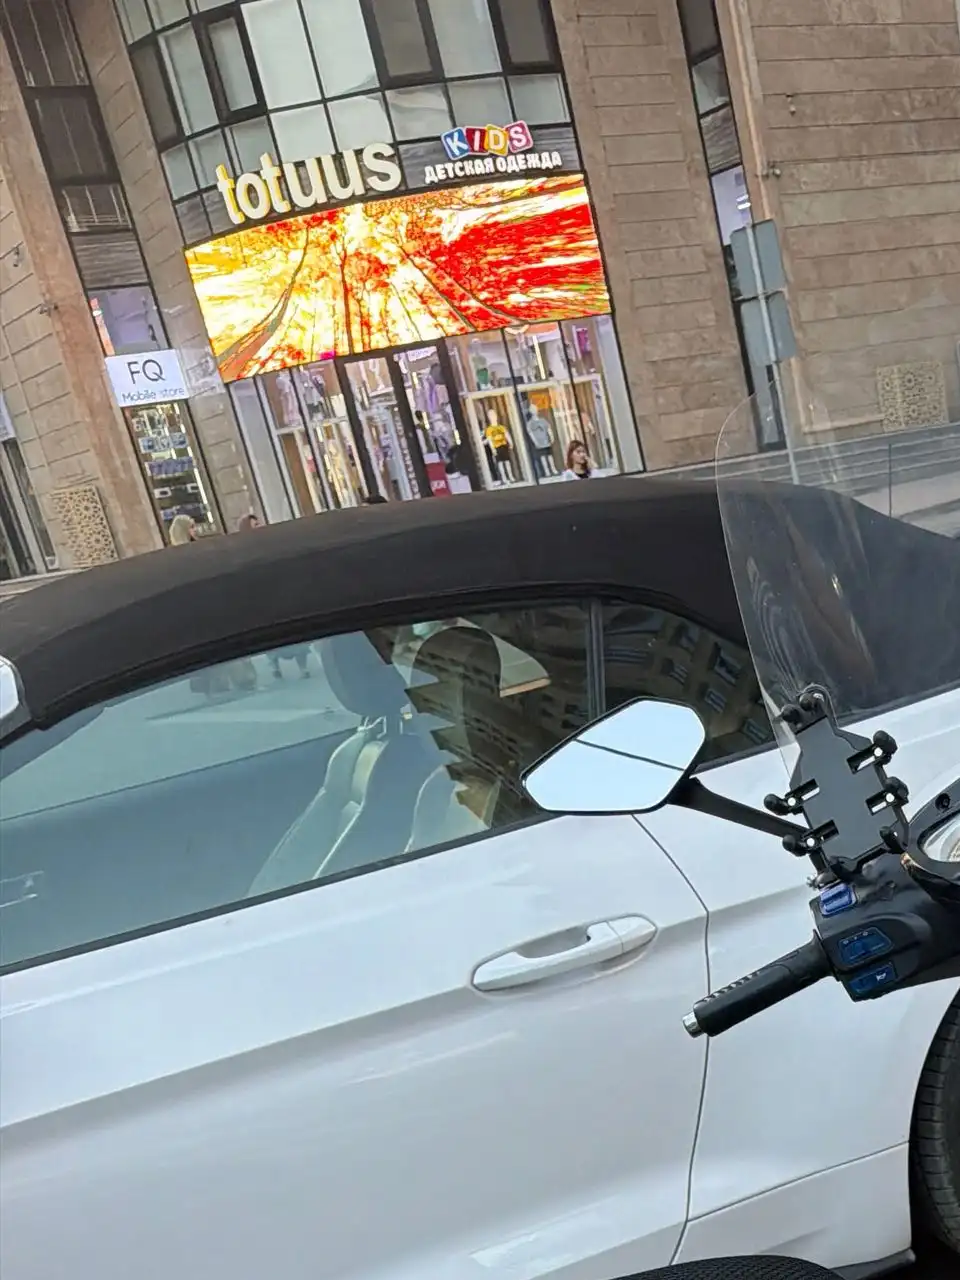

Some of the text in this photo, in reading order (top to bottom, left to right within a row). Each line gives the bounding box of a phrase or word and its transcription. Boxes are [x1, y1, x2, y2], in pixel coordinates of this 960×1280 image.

[443, 123, 531, 159] KIDS
[216, 143, 402, 225] totuus
[424, 151, 562, 184] ДЕТСКАЯ ОДЕЖДА
[127, 359, 166, 384] FQ
[121, 387, 184, 402] Mobile store
